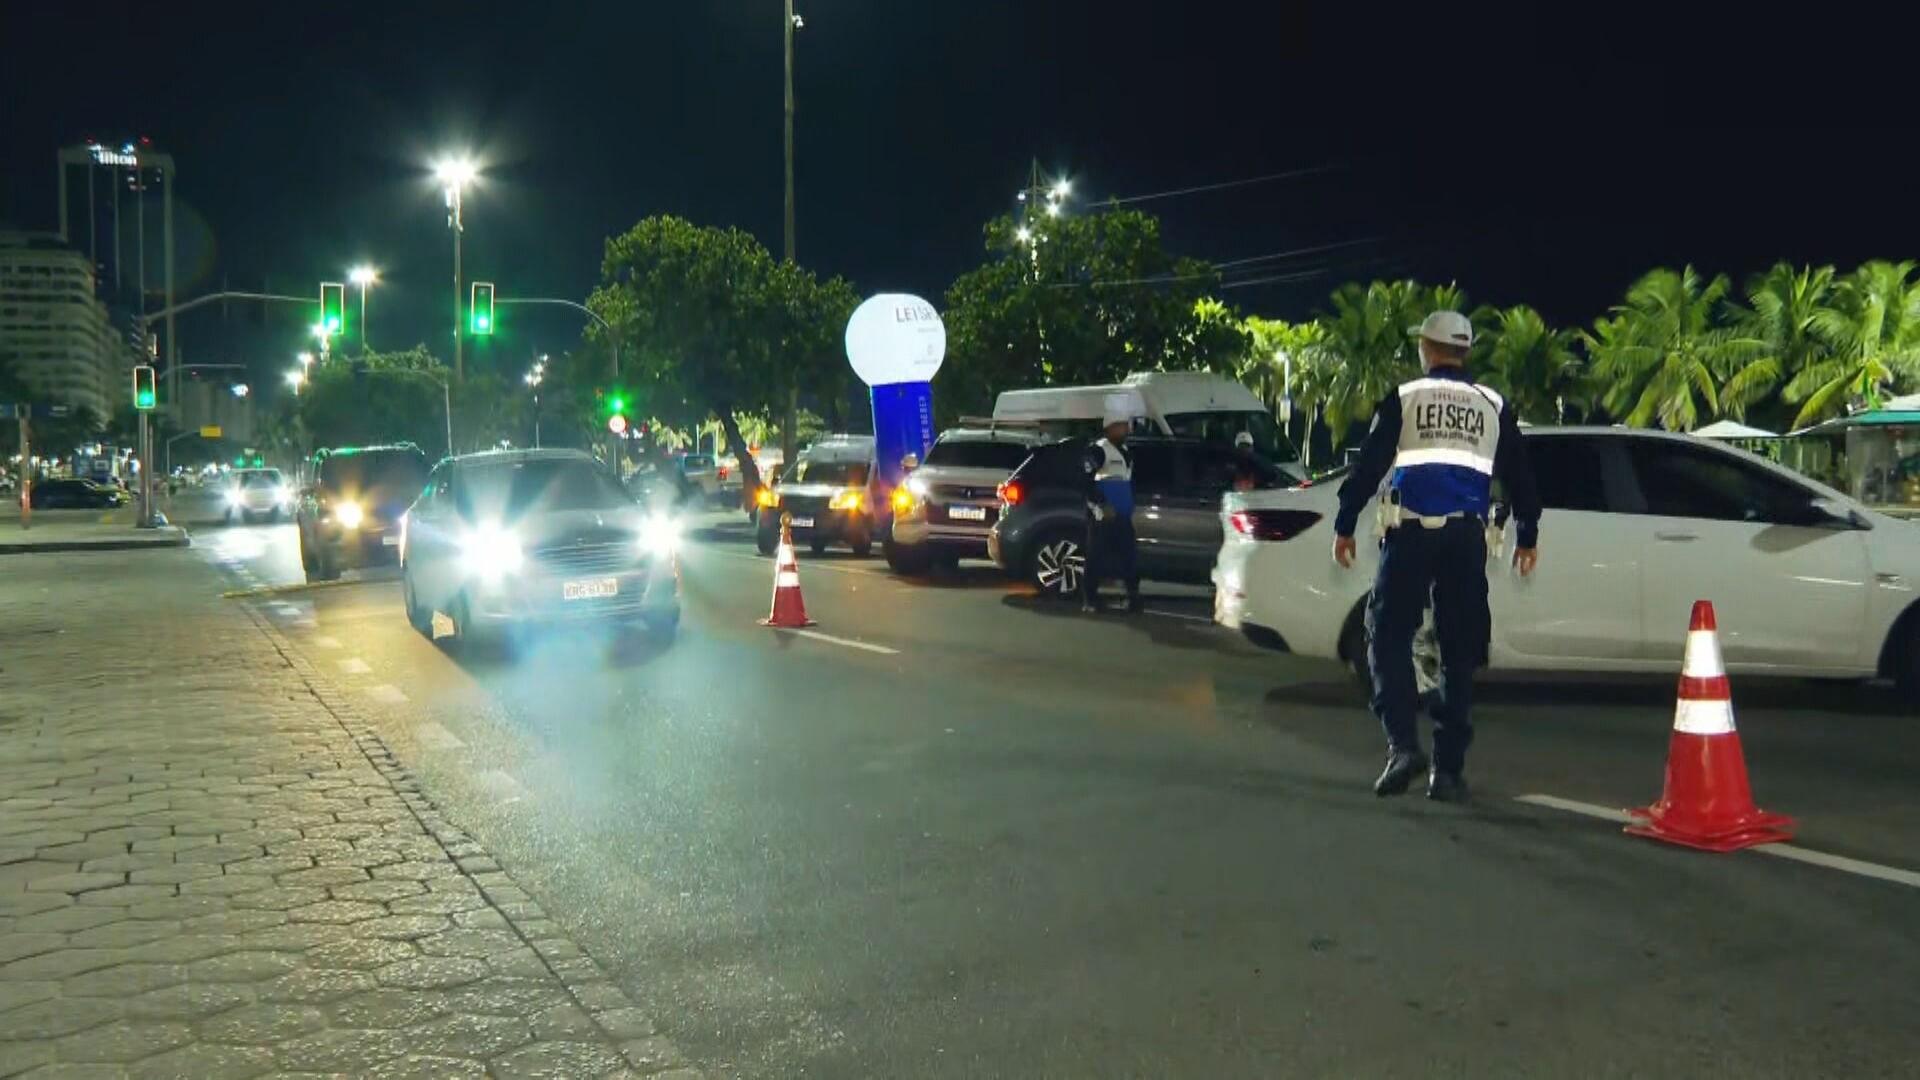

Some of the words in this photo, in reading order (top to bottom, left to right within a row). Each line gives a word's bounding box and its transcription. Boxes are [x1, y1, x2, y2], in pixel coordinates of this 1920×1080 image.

[896, 307, 918, 323] LEI
[1416, 403, 1442, 430] LEI
[1445, 403, 1484, 436] SECA
